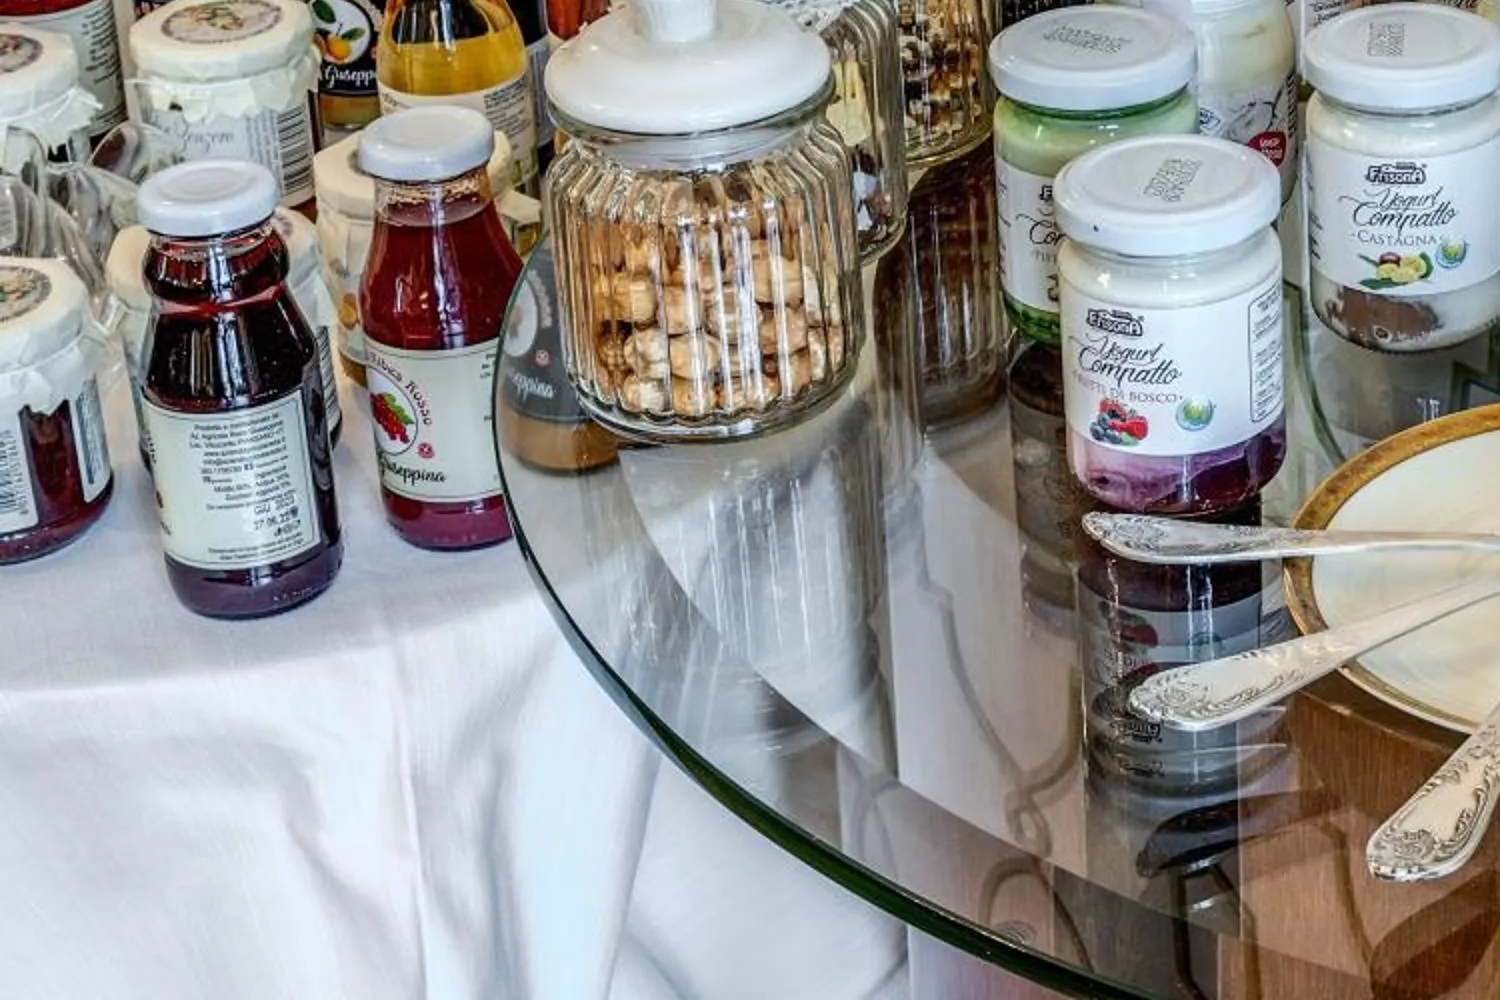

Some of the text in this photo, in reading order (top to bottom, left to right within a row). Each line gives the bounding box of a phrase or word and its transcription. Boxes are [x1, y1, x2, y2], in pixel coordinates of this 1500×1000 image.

[1337, 195, 1460, 232] Compatto
[1363, 186, 1443, 212] Yogurt
[1069, 336, 1183, 387] Compatto
[1085, 333, 1164, 365] Yogurt
